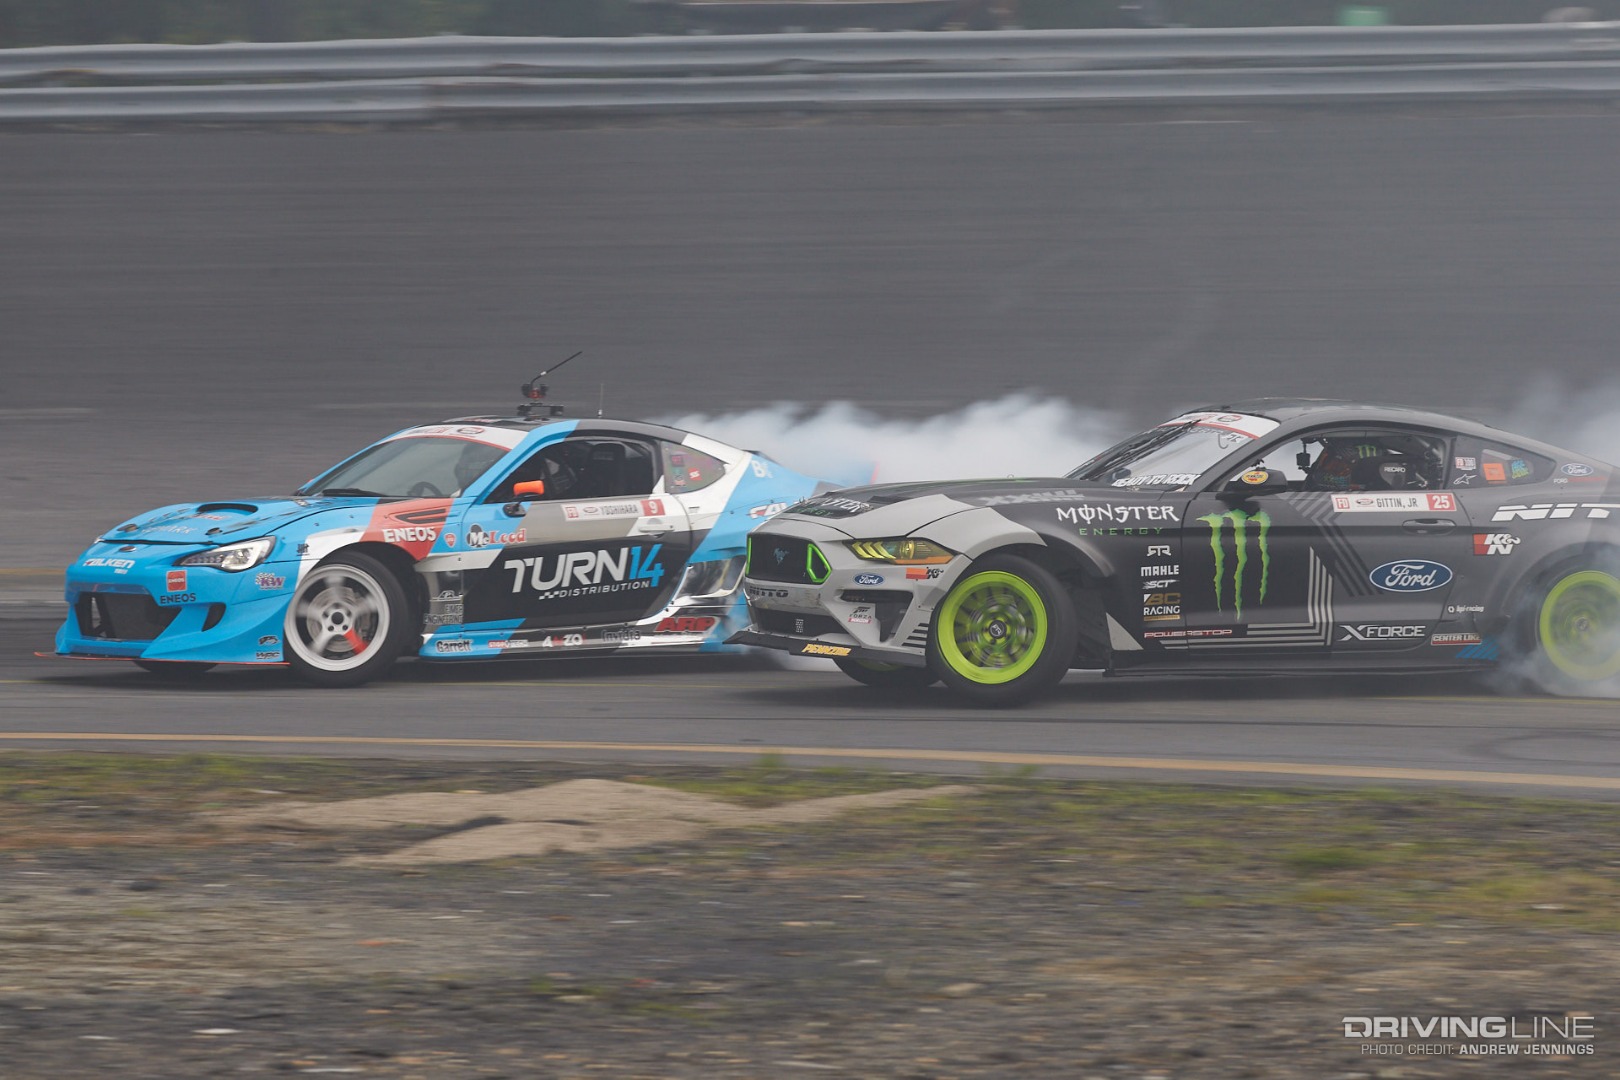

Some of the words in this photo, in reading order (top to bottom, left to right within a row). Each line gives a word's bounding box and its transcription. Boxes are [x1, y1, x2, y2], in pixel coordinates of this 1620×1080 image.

[600, 504, 639, 515] YOSHIHARA
[648, 501, 659, 514] 9
[1376, 499, 1406, 508] GITTIN,
[1407, 498, 1418, 507] JR
[1432, 495, 1451, 509] 25
[1056, 503, 1180, 524] MONSTER
[382, 526, 437, 542] ENEOS
[468, 527, 527, 548] McLeod
[1079, 527, 1162, 535] ENERGY
[83, 558, 136, 569] FALKEN
[1141, 564, 1179, 577] MAHLE
[1385, 564, 1436, 587] Ford
[859, 575, 879, 584] Ford
[1142, 579, 1177, 590] SCT
[559, 581, 650, 598] DISTRIBUTION
[160, 593, 196, 604] ENEOS
[1144, 593, 1181, 606] BC
[1143, 606, 1181, 616] RACING
[655, 617, 716, 633] ARP
[1144, 629, 1233, 639] POWERSTOP
[1433, 634, 1462, 642] CENTER
[437, 640, 472, 653] Garrett
